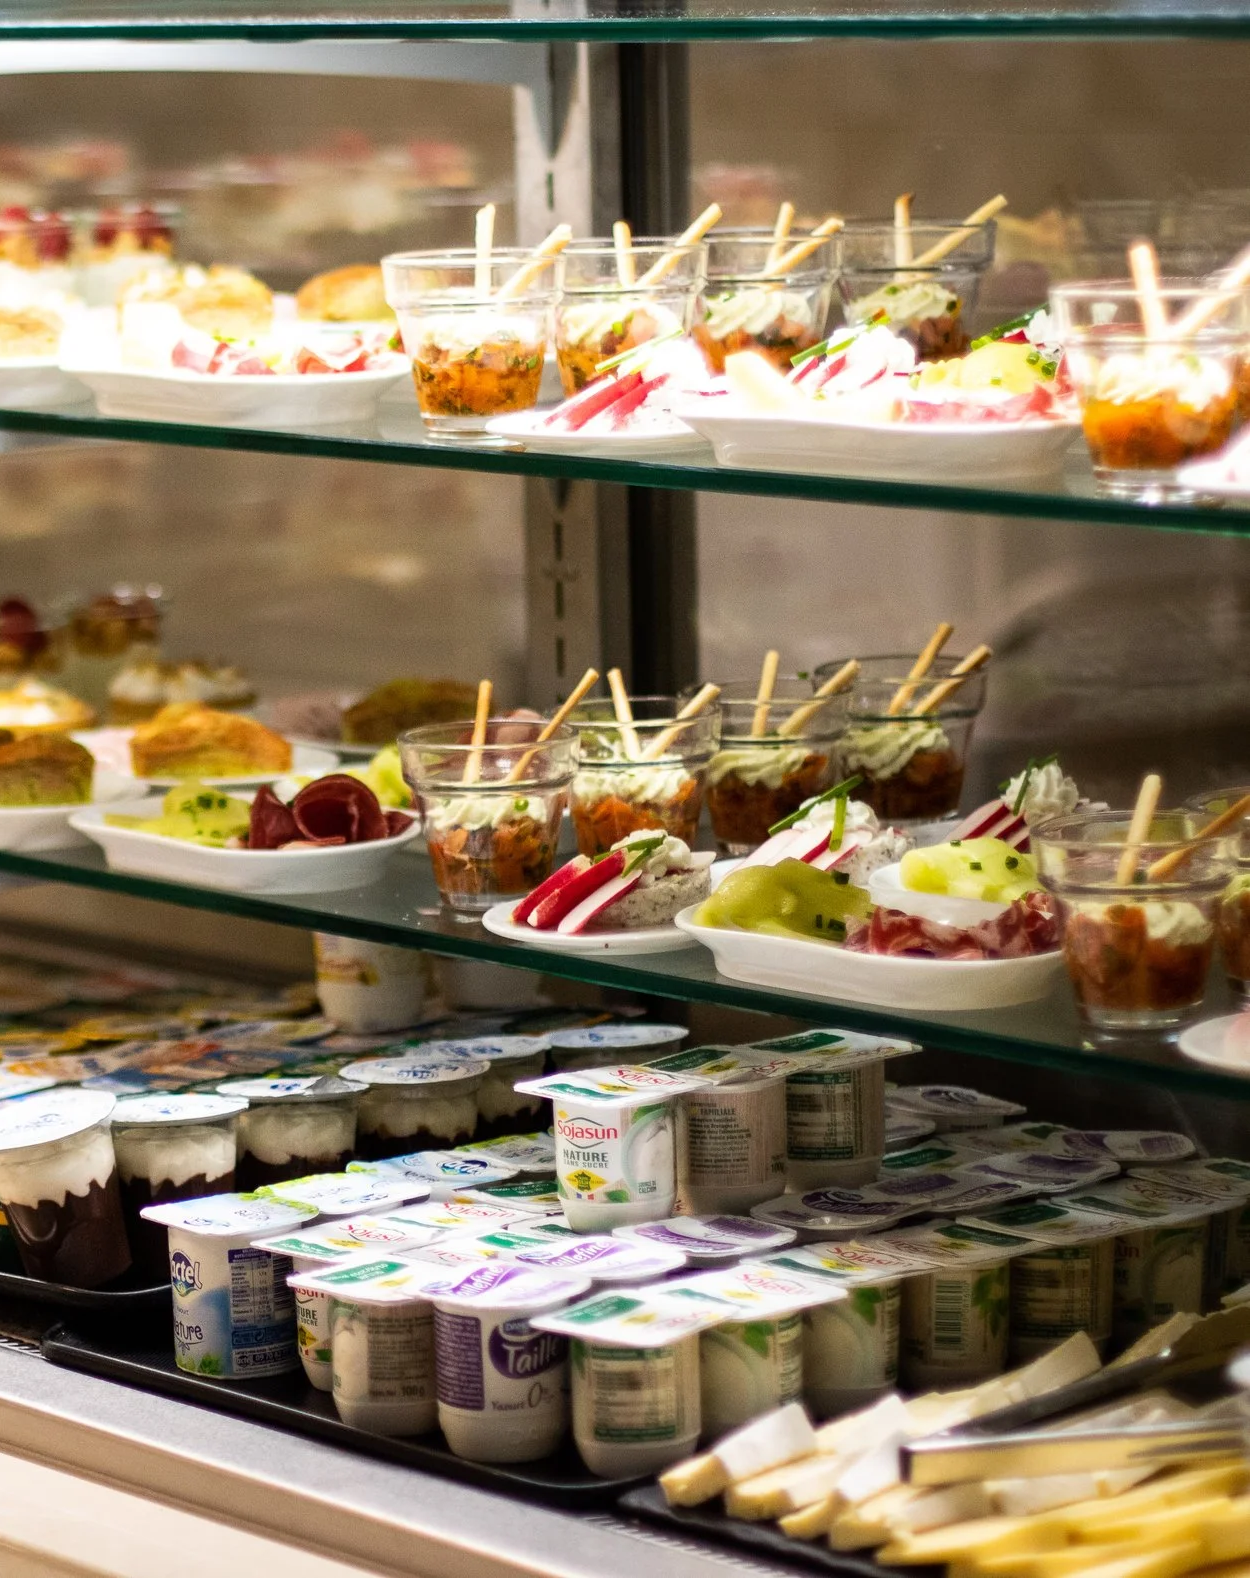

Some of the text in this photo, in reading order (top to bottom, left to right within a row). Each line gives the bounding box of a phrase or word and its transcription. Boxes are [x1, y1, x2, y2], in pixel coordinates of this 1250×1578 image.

[557, 1119, 618, 1140] Sojasun
[563, 1149, 609, 1162] NATURE
[174, 1321, 204, 1341] ature
